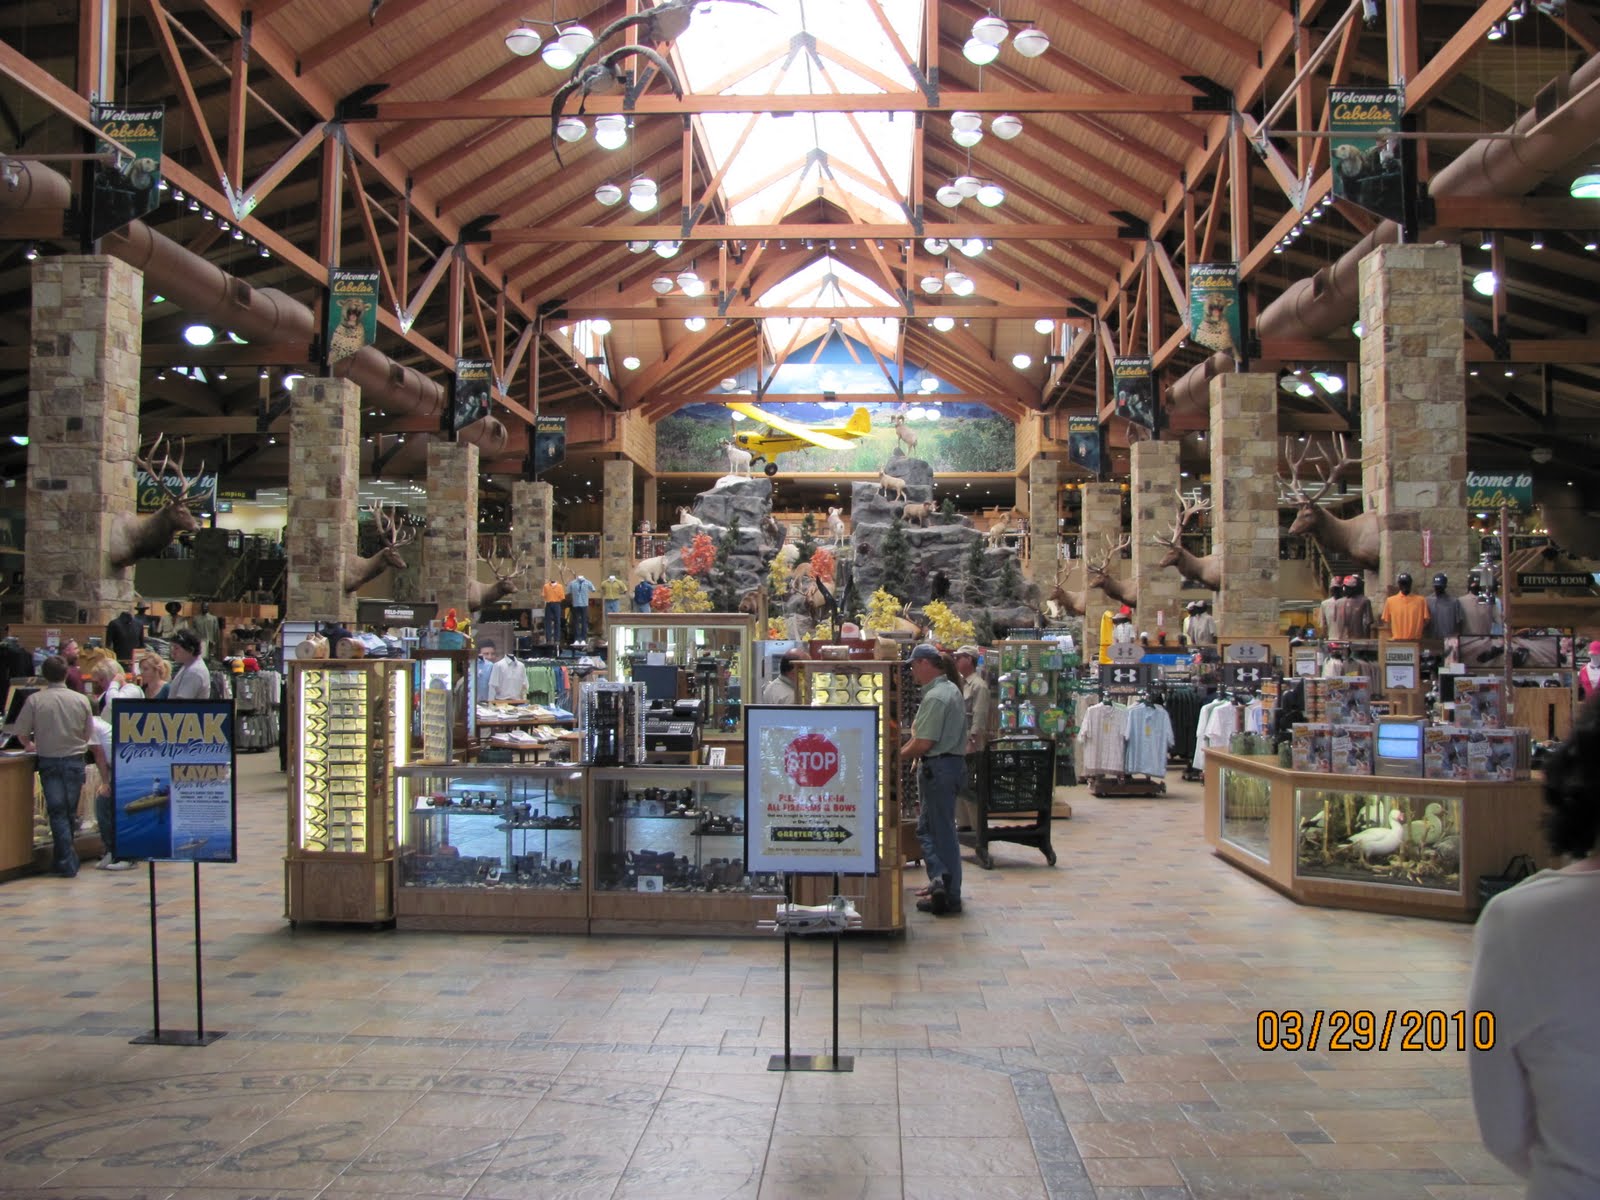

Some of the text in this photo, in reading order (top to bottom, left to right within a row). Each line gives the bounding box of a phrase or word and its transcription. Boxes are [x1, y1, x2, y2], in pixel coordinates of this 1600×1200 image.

[1331, 91, 1397, 104] Welcome to
[101, 109, 163, 121] Welcome to
[1333, 103, 1392, 120] Cabela's
[101, 121, 157, 138] Cabela's
[333, 272, 369, 281] Welcome
[1191, 267, 1236, 276] Welcome to
[334, 281, 375, 293] Cabela's
[1192, 276, 1233, 287] Cabela's
[1114, 358, 1142, 366] Welcome
[201, 474, 215, 488] to
[1466, 471, 1532, 487] lcome to
[1523, 575, 1587, 585] FITTING ROOM
[1386, 652, 1413, 661] LEGENDARY
[119, 712, 229, 744] KAYAK
[119, 738, 228, 764] Gear Up Event
[786, 751, 836, 772] STOP
[173, 765, 231, 783] KAYAK
[767, 803, 780, 812] ALL
[833, 804, 856, 812] BOWS
[777, 830, 821, 838] GREETER'S
